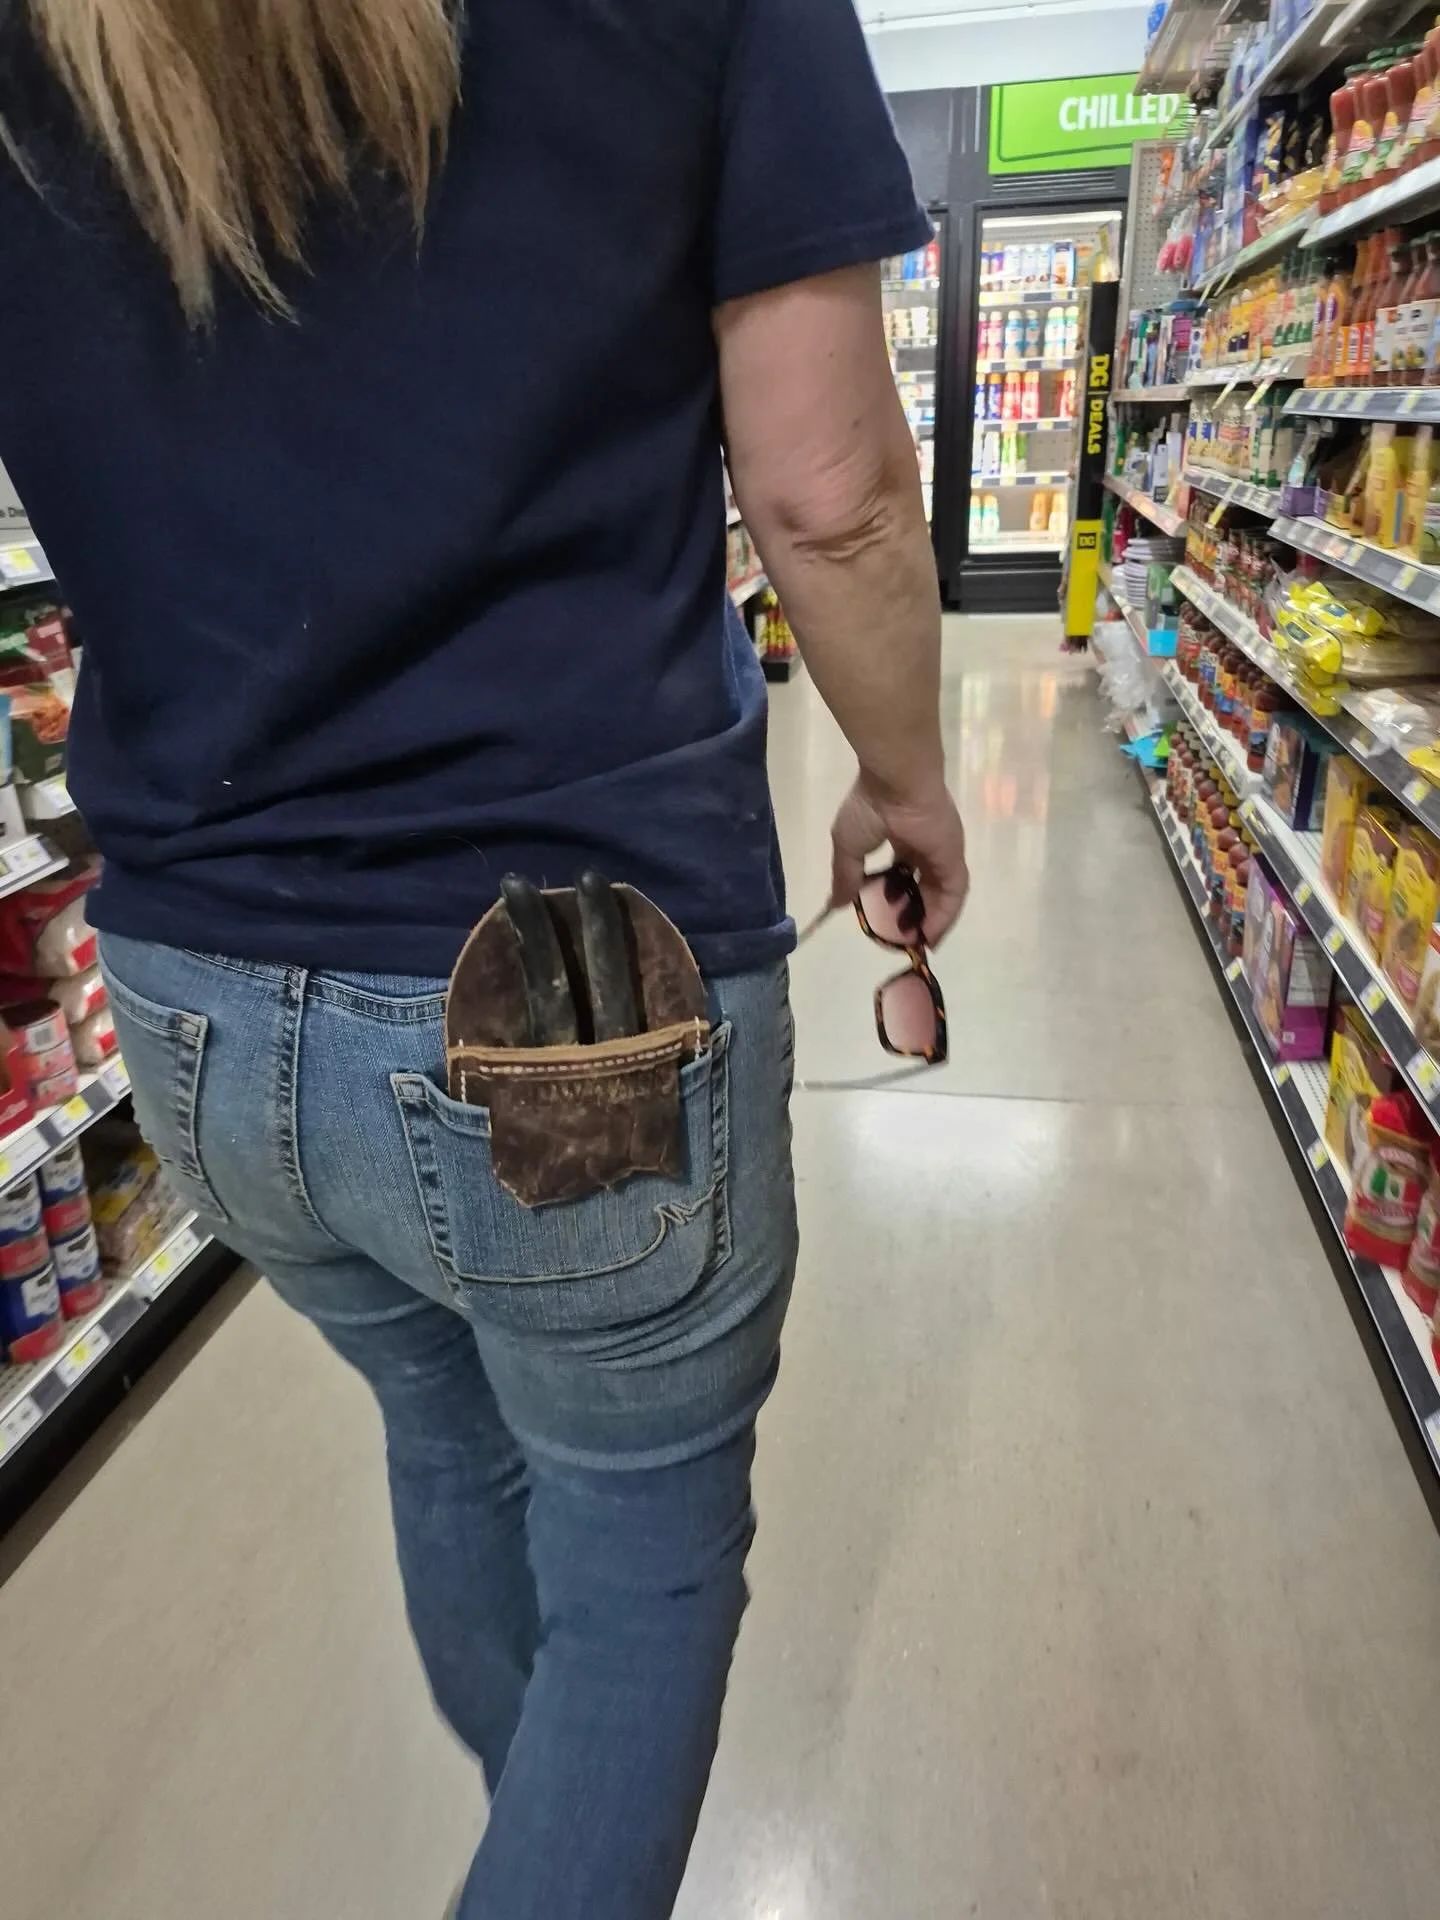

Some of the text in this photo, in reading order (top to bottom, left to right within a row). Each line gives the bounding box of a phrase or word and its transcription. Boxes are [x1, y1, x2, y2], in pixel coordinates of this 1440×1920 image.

[1058, 93, 1180, 131] CHILLED
[1087, 353, 1110, 455] DG DEALS
[1079, 535, 1096, 547] DG
